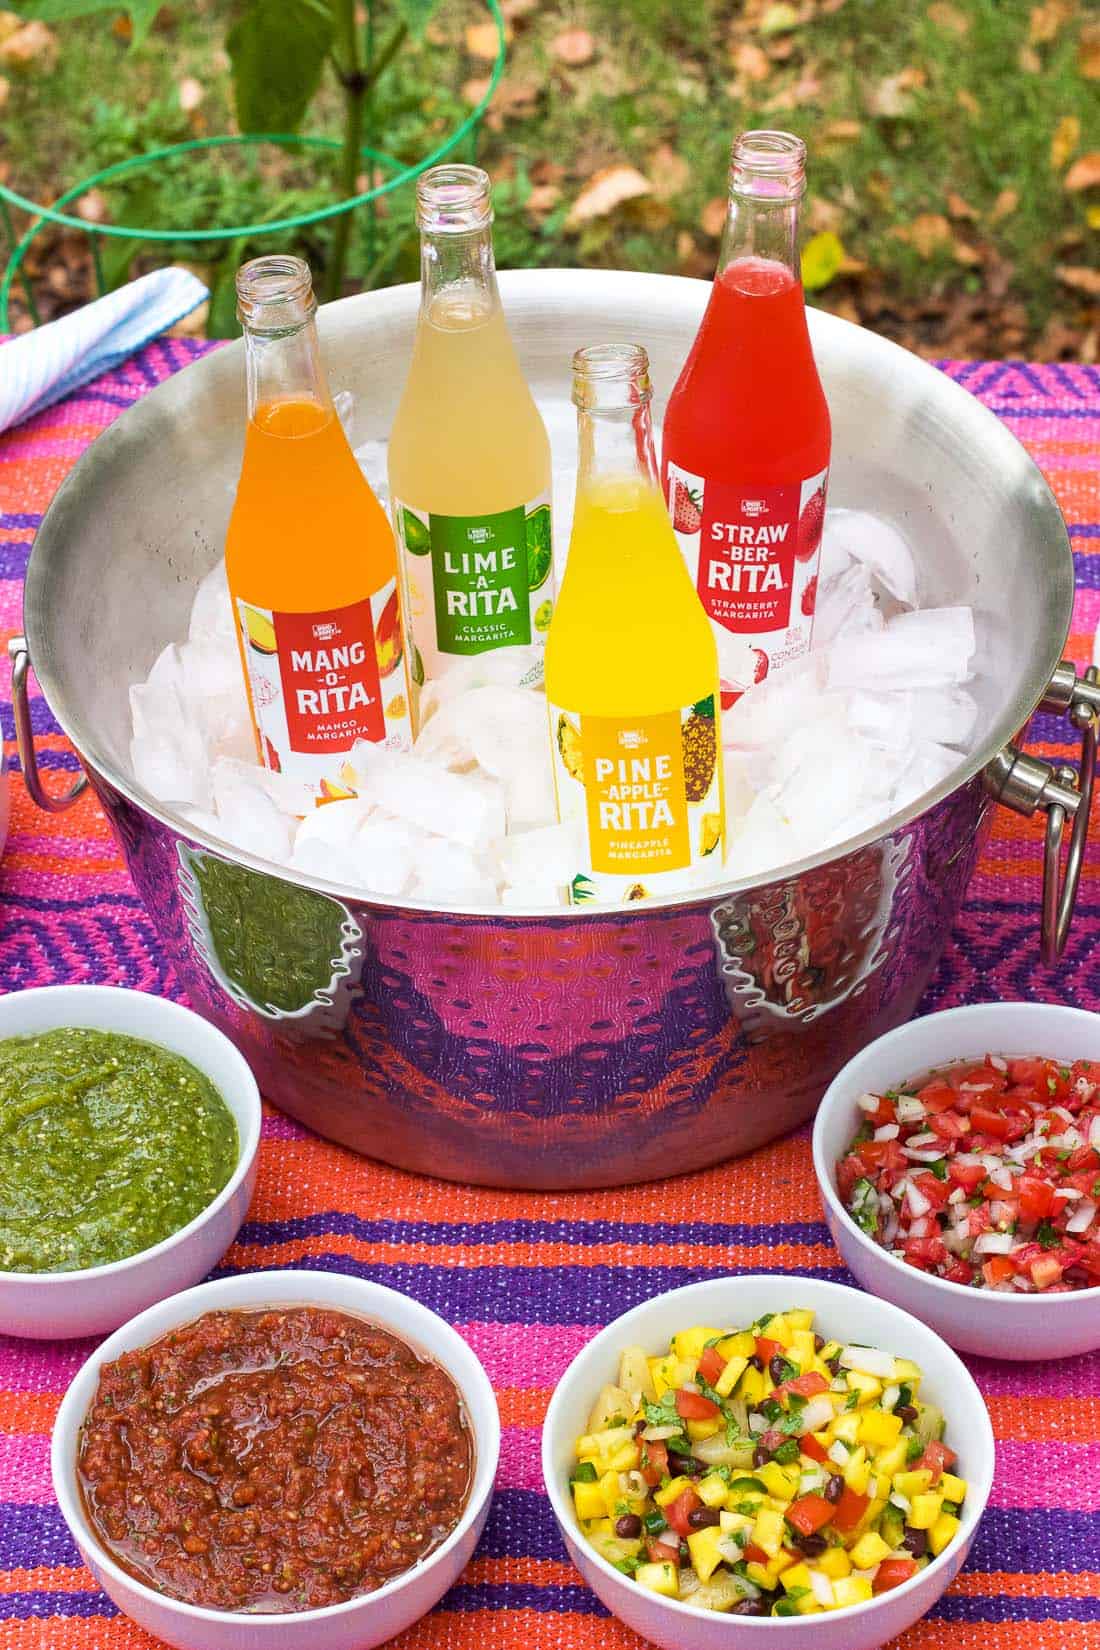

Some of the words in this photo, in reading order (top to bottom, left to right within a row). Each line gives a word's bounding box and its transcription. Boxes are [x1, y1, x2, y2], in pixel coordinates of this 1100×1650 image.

[711, 522, 790, 545] STRAW
[444, 547, 516, 574] LIME
[722, 546, 776, 562] -BER-
[469, 576, 495, 590] -A-
[446, 587, 518, 616] RITA
[711, 599, 779, 610] STRAWBERRY
[713, 609, 775, 620] MARGARITA
[463, 623, 507, 634] CLASSIC
[455, 630, 515, 642] MARGARITA
[290, 641, 365, 672] MANG
[317, 672, 347, 687] -O-
[317, 719, 357, 731] MANGO
[307, 726, 369, 740] MARGARITA
[595, 755, 672, 782] PINE
[601, 782, 670, 800] -APPLE-
[600, 800, 675, 831] RITA
[609, 838, 669, 849] PINEAPPLE
[608, 848, 672, 859] MARGARITA
